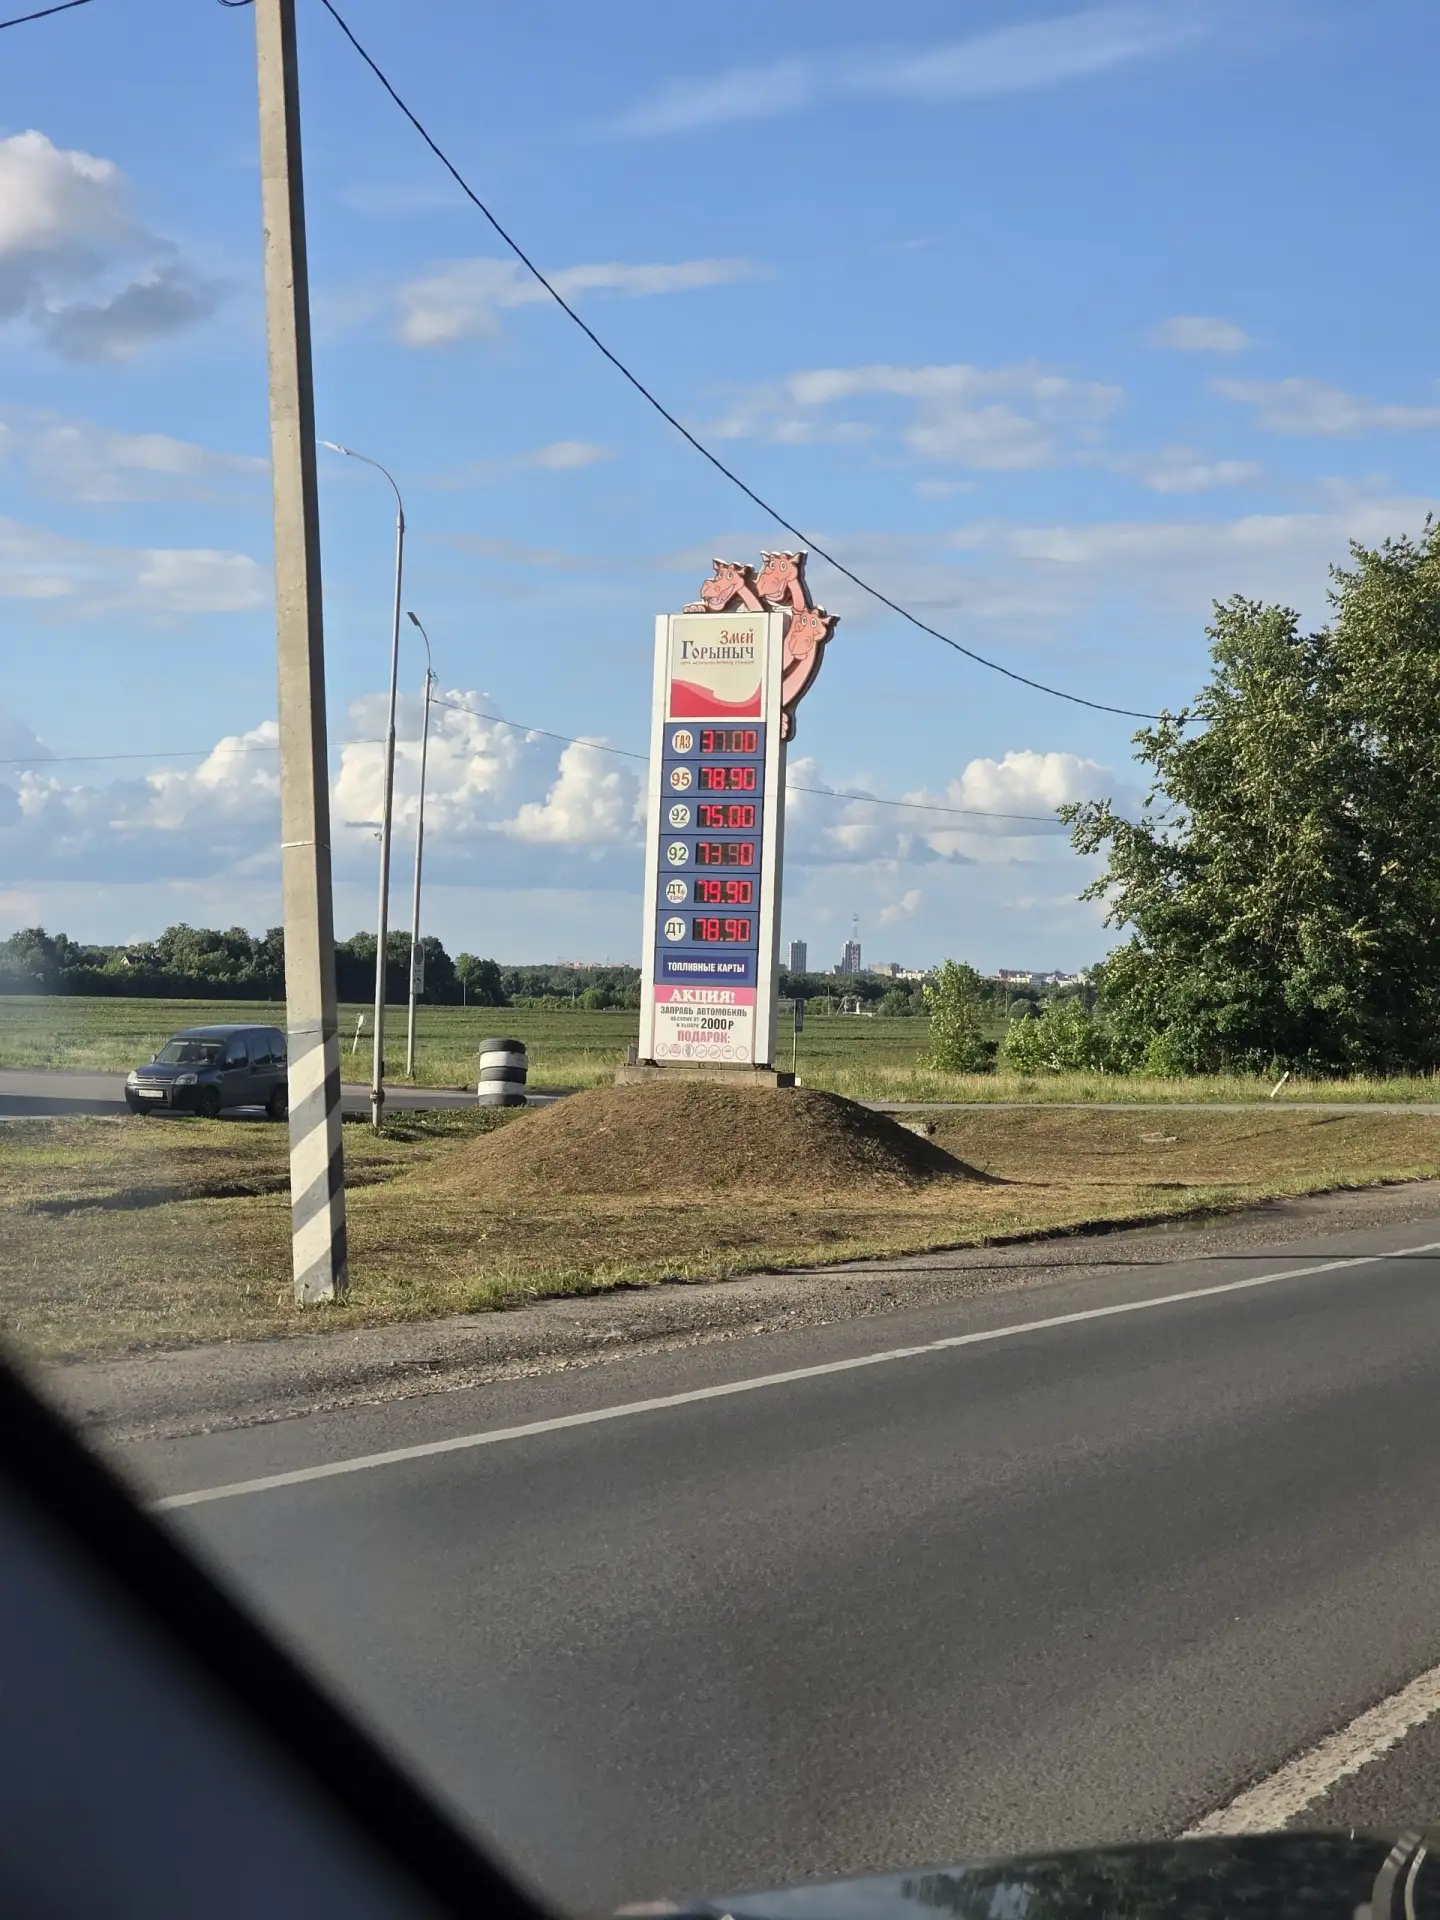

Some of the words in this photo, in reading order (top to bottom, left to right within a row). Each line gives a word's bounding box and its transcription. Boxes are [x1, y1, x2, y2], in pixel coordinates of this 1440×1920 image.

[675, 735, 691, 749] ГАЗ
[672, 773, 690, 786] 95
[672, 809, 688, 821] 92
[700, 806, 754, 827] 75.00
[669, 847, 687, 861] 92
[666, 923, 684, 936] ДТ
[668, 962, 716, 972] ТОПЛИВНЫЕ
[717, 964, 745, 973] КАРТЫ
[670, 989, 735, 1004] АКЦИЯ!
[661, 1006, 694, 1015] ЗАПРАВЬ
[697, 1008, 747, 1017] АВТОМОБИЛЬ
[678, 1030, 731, 1044] ПОДАРОК:
